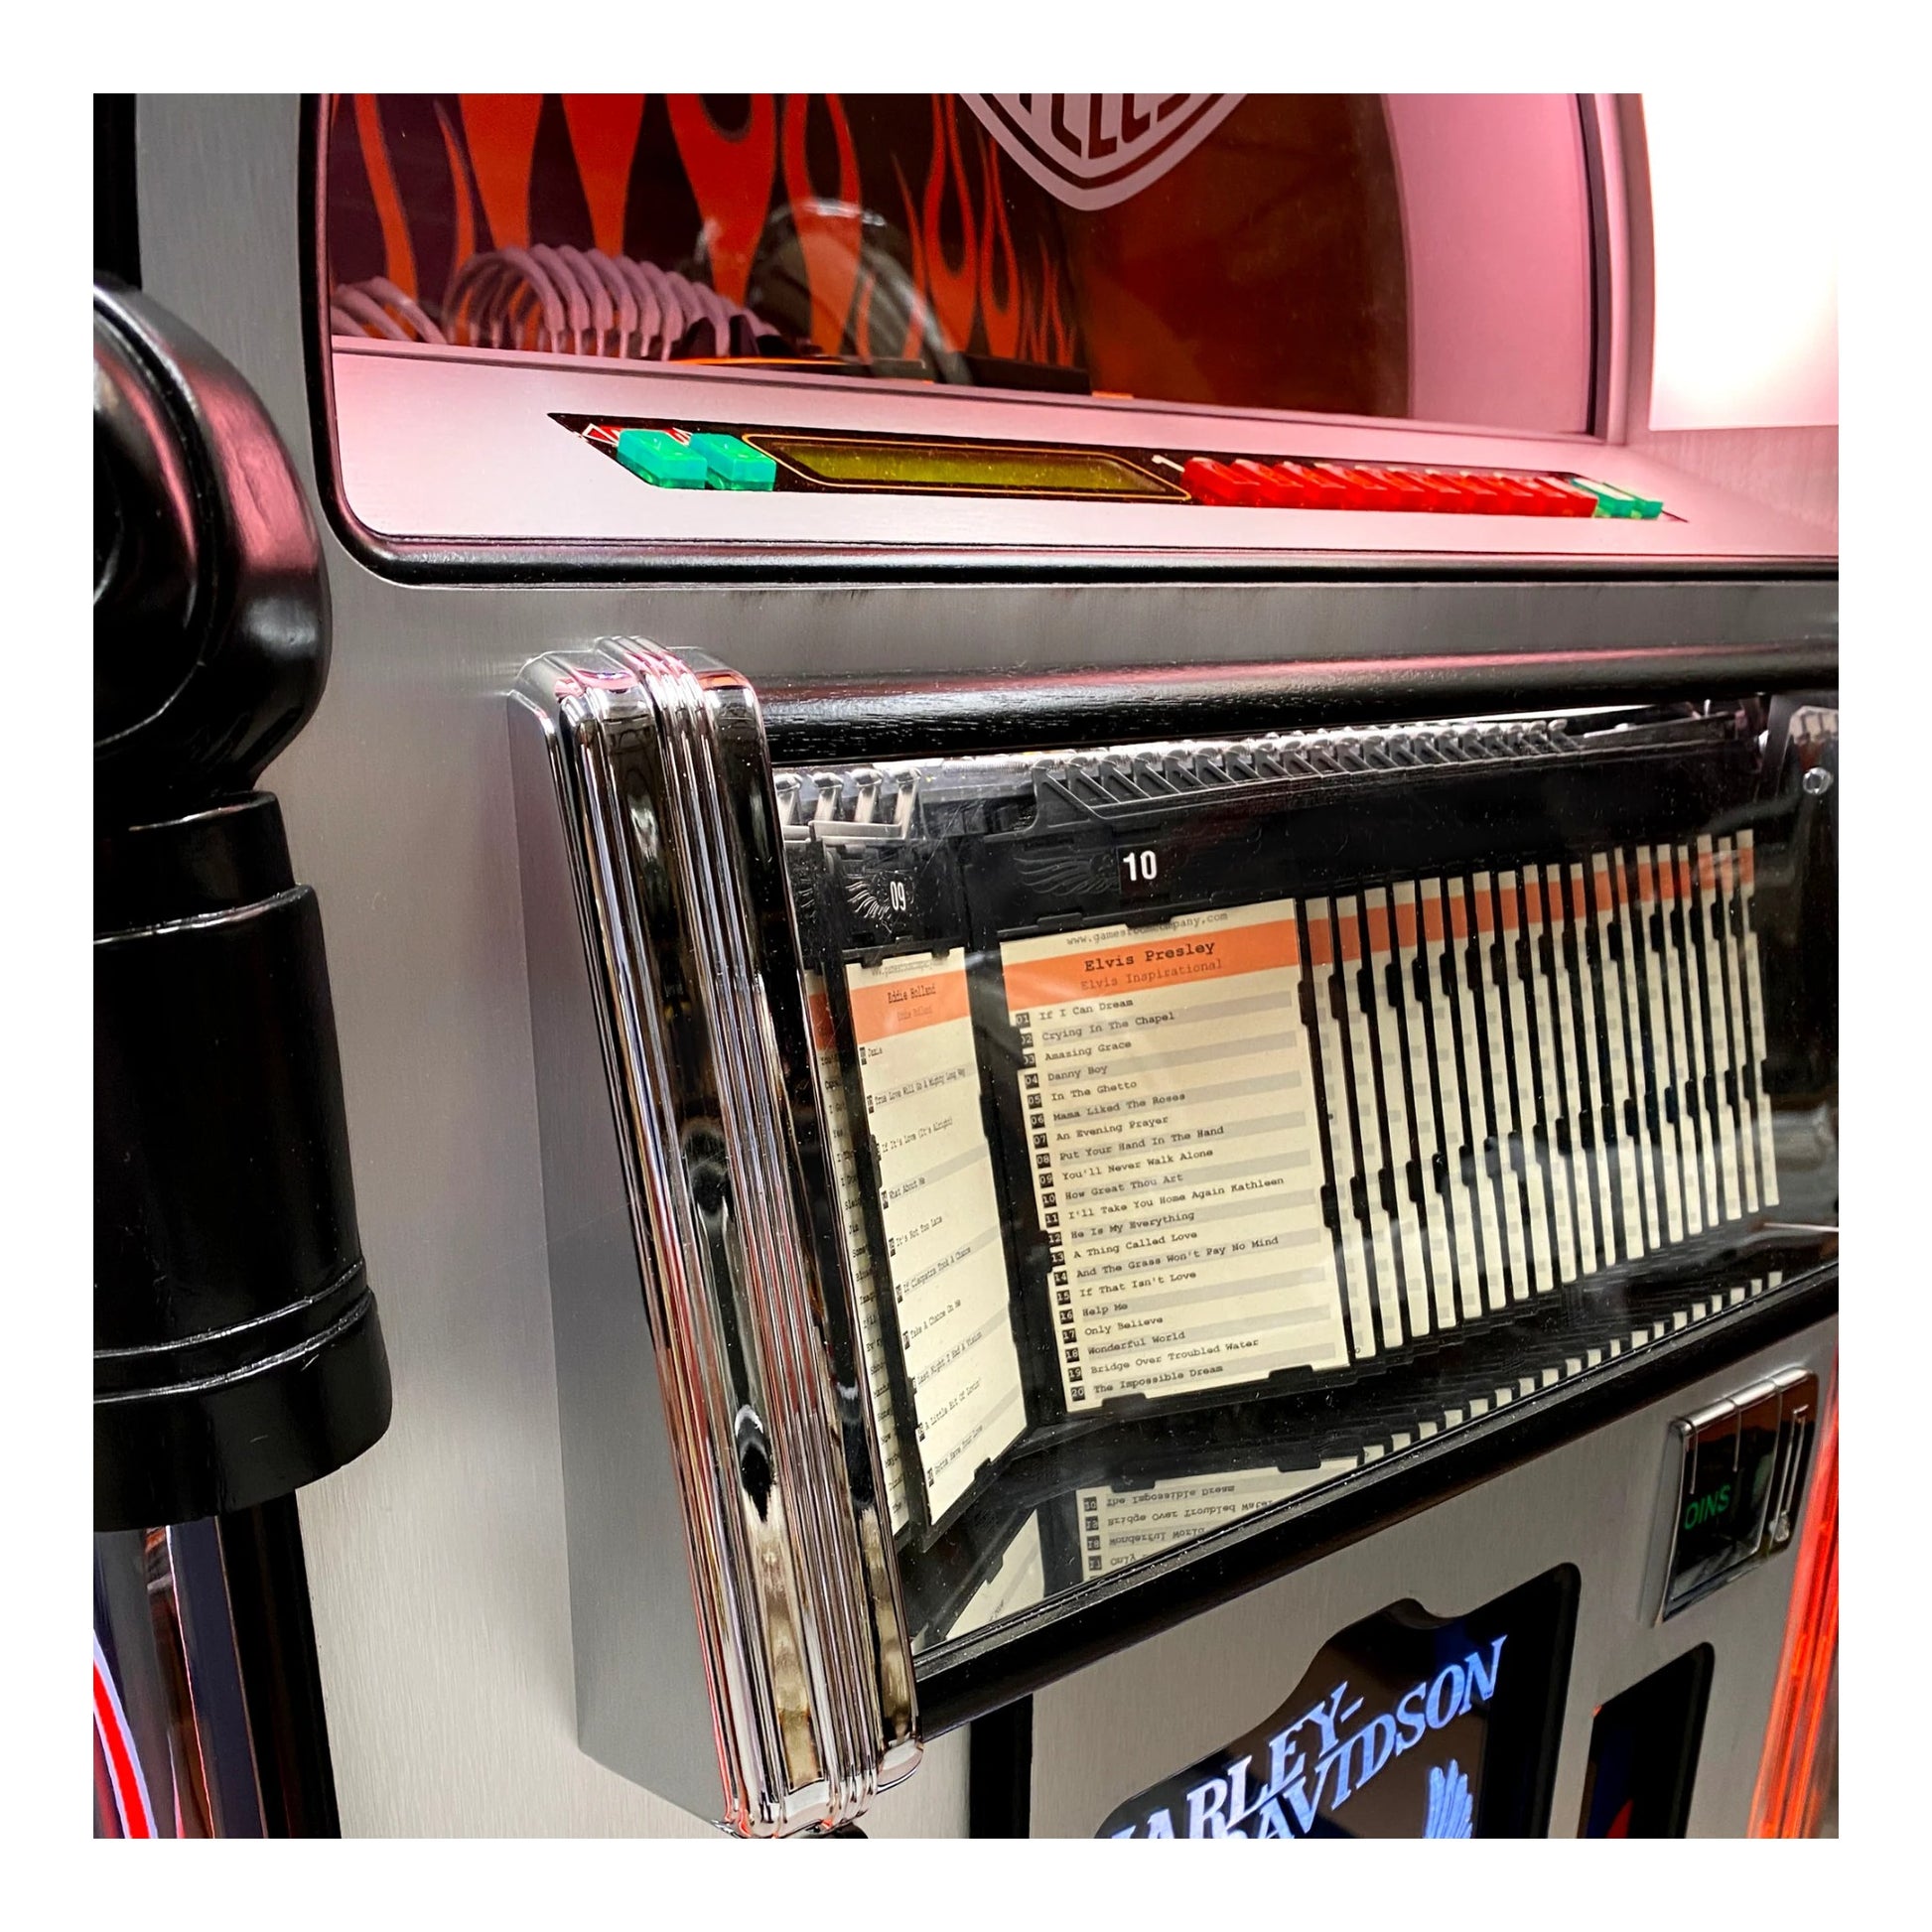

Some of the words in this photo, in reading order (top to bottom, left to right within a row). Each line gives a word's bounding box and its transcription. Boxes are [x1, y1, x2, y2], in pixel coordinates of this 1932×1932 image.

[1123, 851, 1157, 881] 10
[891, 882, 905, 911] 09
[1084, 955, 1135, 972] Elvis
[1145, 942, 1215, 962] Presley
[1081, 977, 1118, 991] Elvis
[1127, 959, 1222, 984] Inspirational
[1039, 1011, 1052, 1021] If
[1072, 1005, 1093, 1015] Can
[1100, 999, 1134, 1011] Dream
[1042, 1027, 1082, 1040] Crying
[1090, 1025, 1102, 1034] In
[1108, 1021, 1129, 1031] The
[1135, 1012, 1175, 1027] Chapel
[1044, 1046, 1092, 1061] Amazing
[1098, 1040, 1132, 1052] Grace
[1048, 1068, 1081, 1082] Danny
[1088, 1064, 1108, 1075] Boy
[1051, 1092, 1064, 1102] In
[1070, 1088, 1090, 1098] The
[1096, 1080, 1138, 1094] Ghetto
[1053, 1111, 1080, 1122] Mama
[1086, 1104, 1120, 1116] Liked
[1126, 1100, 1146, 1110] The
[1153, 1093, 1185, 1105] Roses
[1056, 1132, 1070, 1142] An
[1076, 1124, 1122, 1138] Evening
[1129, 1116, 1168, 1130] Prayer
[1060, 1152, 1080, 1162] Put
[1085, 1146, 1112, 1157] Your
[1119, 1140, 1146, 1152] Hand
[1152, 1136, 1166, 1146] In
[1171, 1132, 1191, 1142] The
[1197, 1126, 1224, 1138] Hand
[1062, 1168, 1102, 1179] You'll
[1108, 1160, 1142, 1173] Never
[1147, 1154, 1173, 1166] Walk
[1179, 1149, 1213, 1161] Alone
[1064, 1190, 1086, 1201] How
[1092, 1183, 1126, 1195] Great
[1130, 1179, 1158, 1190] Thou
[1163, 1173, 1183, 1184] Art
[1068, 1208, 1094, 1220] I'll
[1101, 1203, 1128, 1215] Take
[1134, 1199, 1154, 1209] You
[1160, 1193, 1185, 1205] Home
[1191, 1185, 1225, 1199] Again
[1231, 1176, 1285, 1193] Kathleen
[1070, 1229, 1084, 1240] He
[1092, 1227, 1104, 1237] Is
[1110, 1223, 1124, 1234] My
[1130, 1211, 1195, 1229] Everything
[1076, 1267, 1098, 1279] And
[1102, 1264, 1123, 1275] The
[1128, 1257, 1162, 1270] Grass
[1167, 1251, 1200, 1263] Won't
[1206, 1246, 1227, 1257] Pay
[1251, 1235, 1279, 1249] Mind
[1086, 1245, 1120, 1257] Thing
[1126, 1236, 1166, 1250] Called
[1172, 1231, 1197, 1242] Love
[1080, 1287, 1093, 1298] If
[1098, 1283, 1126, 1295] That
[1132, 1277, 1164, 1289] Isn't
[1170, 1271, 1197, 1282] Love
[1082, 1305, 1109, 1316] Help
[1114, 1303, 1128, 1311] Me
[1085, 1324, 1112, 1336] Only
[1118, 1316, 1164, 1330] Believe
[1088, 1338, 1146, 1355] Wonderful
[1152, 1331, 1185, 1344] World
[1090, 1362, 1130, 1374] Bridge
[1136, 1355, 1162, 1366] Over
[1168, 1344, 1221, 1361] Troubled
[1225, 1338, 1259, 1351] Water
[1094, 1384, 1114, 1394] The
[1120, 1371, 1184, 1390] Impossible
[1189, 1364, 1223, 1378] Dream
[1226, 1634, 1507, 1839] AVIDSON
[1111, 1681, 1364, 1839] ARLEY-
